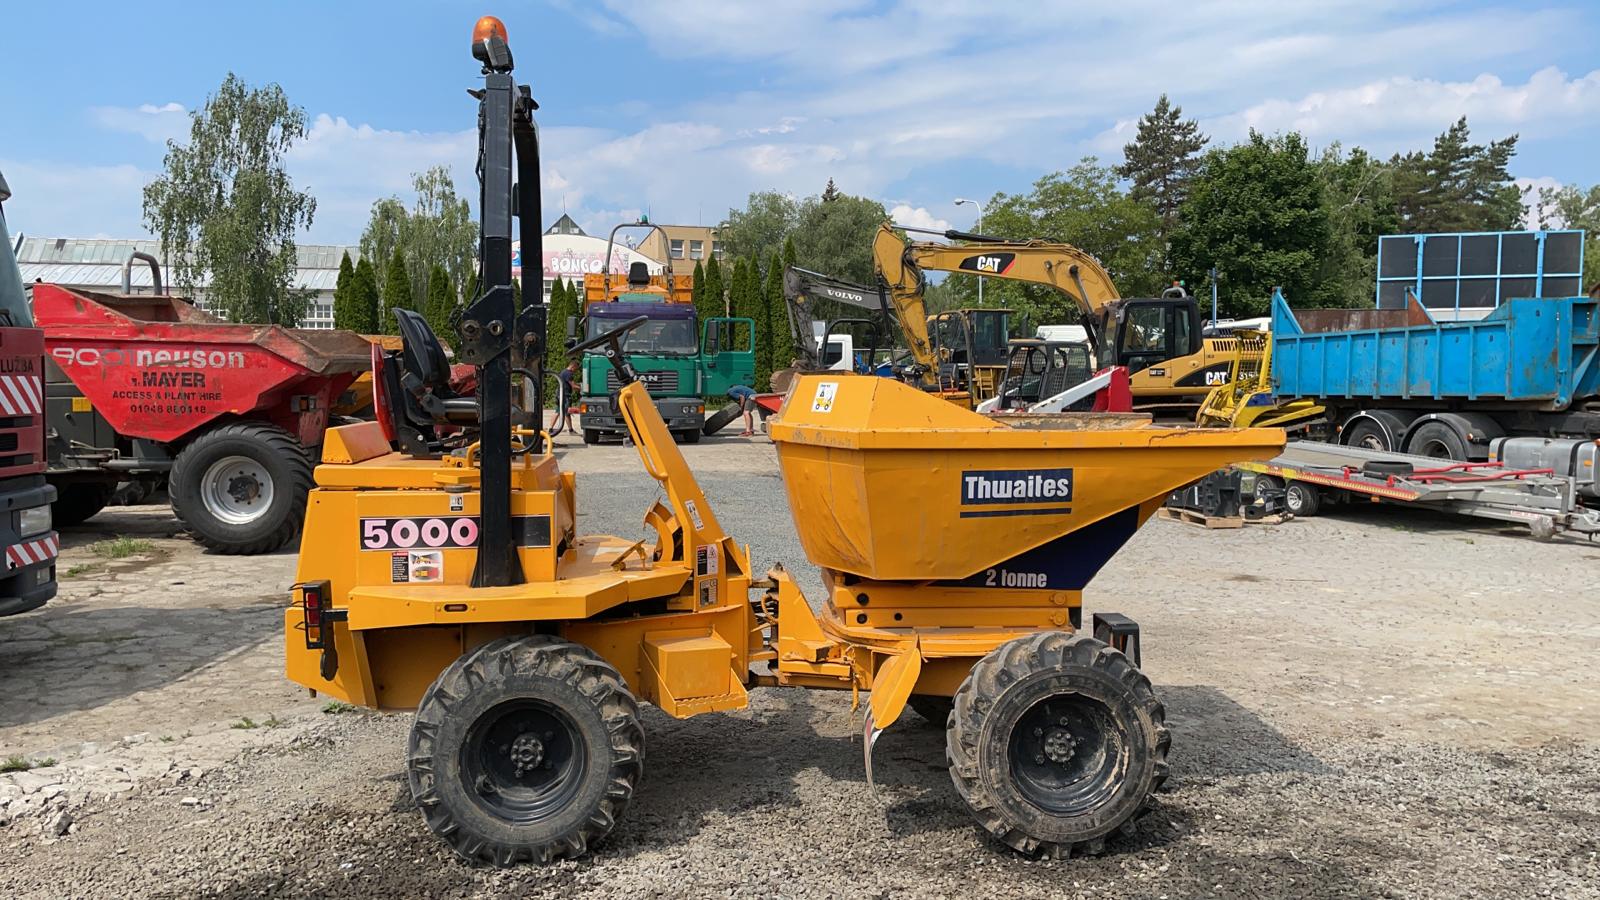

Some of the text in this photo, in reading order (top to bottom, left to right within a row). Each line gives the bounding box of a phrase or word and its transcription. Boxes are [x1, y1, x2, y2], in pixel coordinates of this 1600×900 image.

[551, 257, 603, 273] BONGO
[977, 255, 1001, 272] CAT
[827, 289, 862, 302] VOLVO
[136, 349, 246, 368] neuson
[142, 371, 206, 388] MAYER
[1206, 371, 1226, 385] CAT
[112, 390, 153, 400] ACCESS
[164, 391, 197, 401] PLANT
[200, 392, 223, 401] HIRE
[965, 475, 1069, 499] Thwaites
[363, 517, 479, 549] 5000
[985, 569, 1048, 588] 2 tonne
